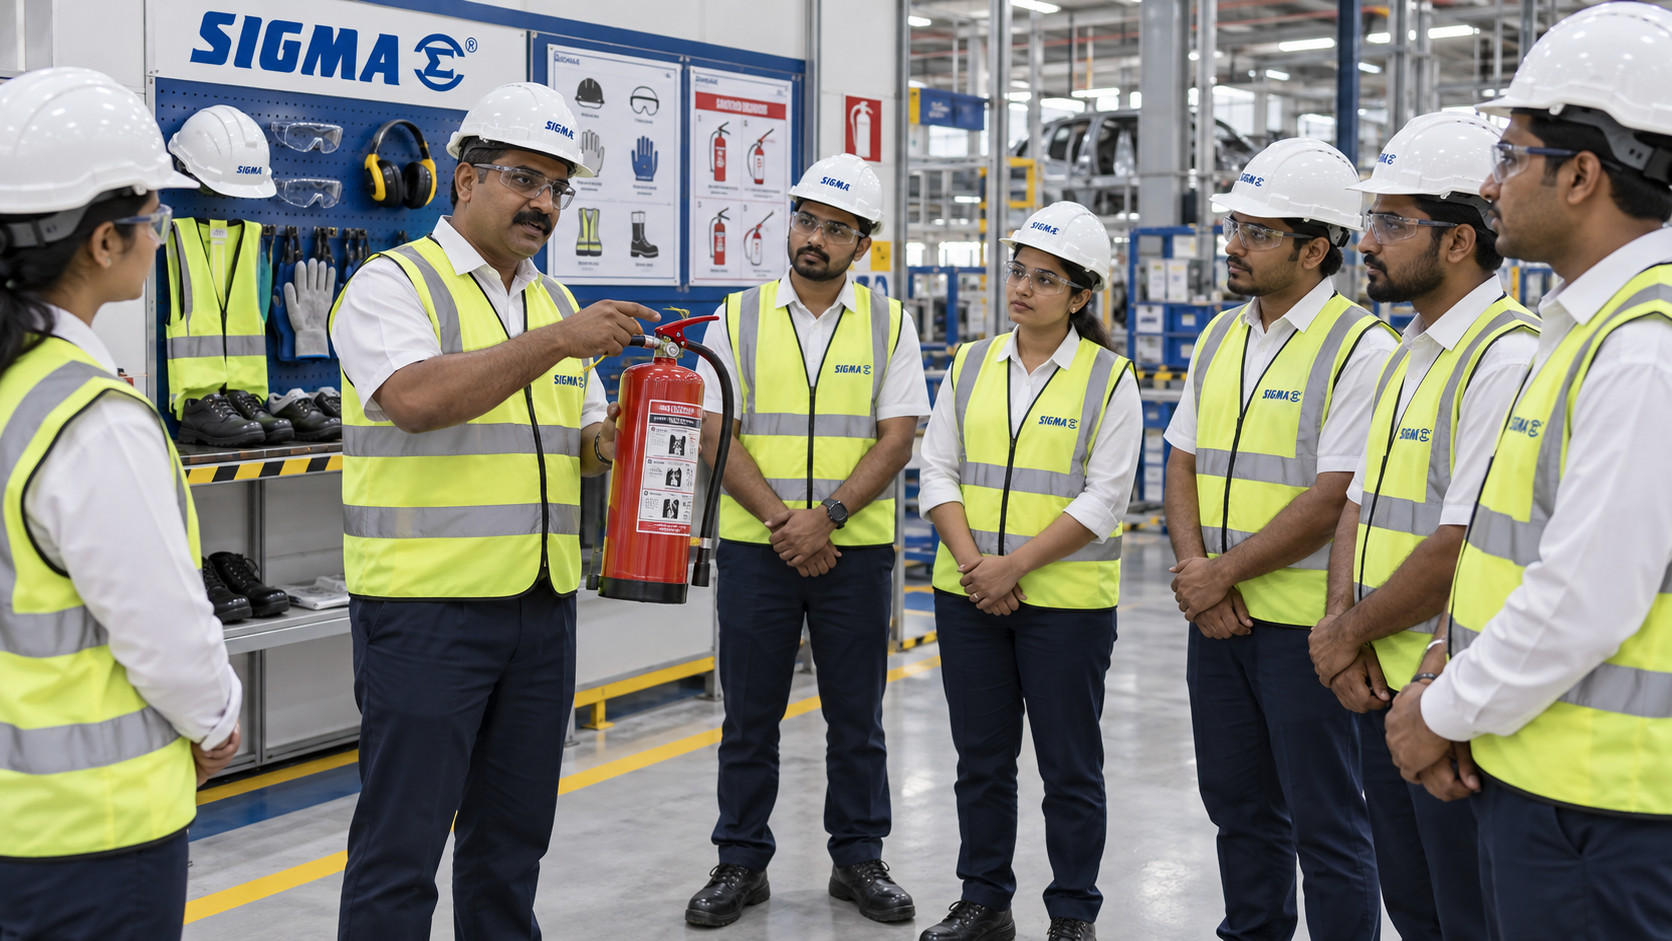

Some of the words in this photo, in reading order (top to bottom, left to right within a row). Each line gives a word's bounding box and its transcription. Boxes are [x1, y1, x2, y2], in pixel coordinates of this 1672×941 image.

[190, 10, 400, 86] SIGMA
[545, 121, 574, 140] SIGMA
[237, 165, 263, 175] SIGMA
[820, 177, 850, 192] SIGMA
[834, 364, 861, 375] SIGMA
[554, 374, 578, 387] SIGMA
[1262, 389, 1289, 400] SIGMA
[1039, 416, 1067, 427] SIGMA
